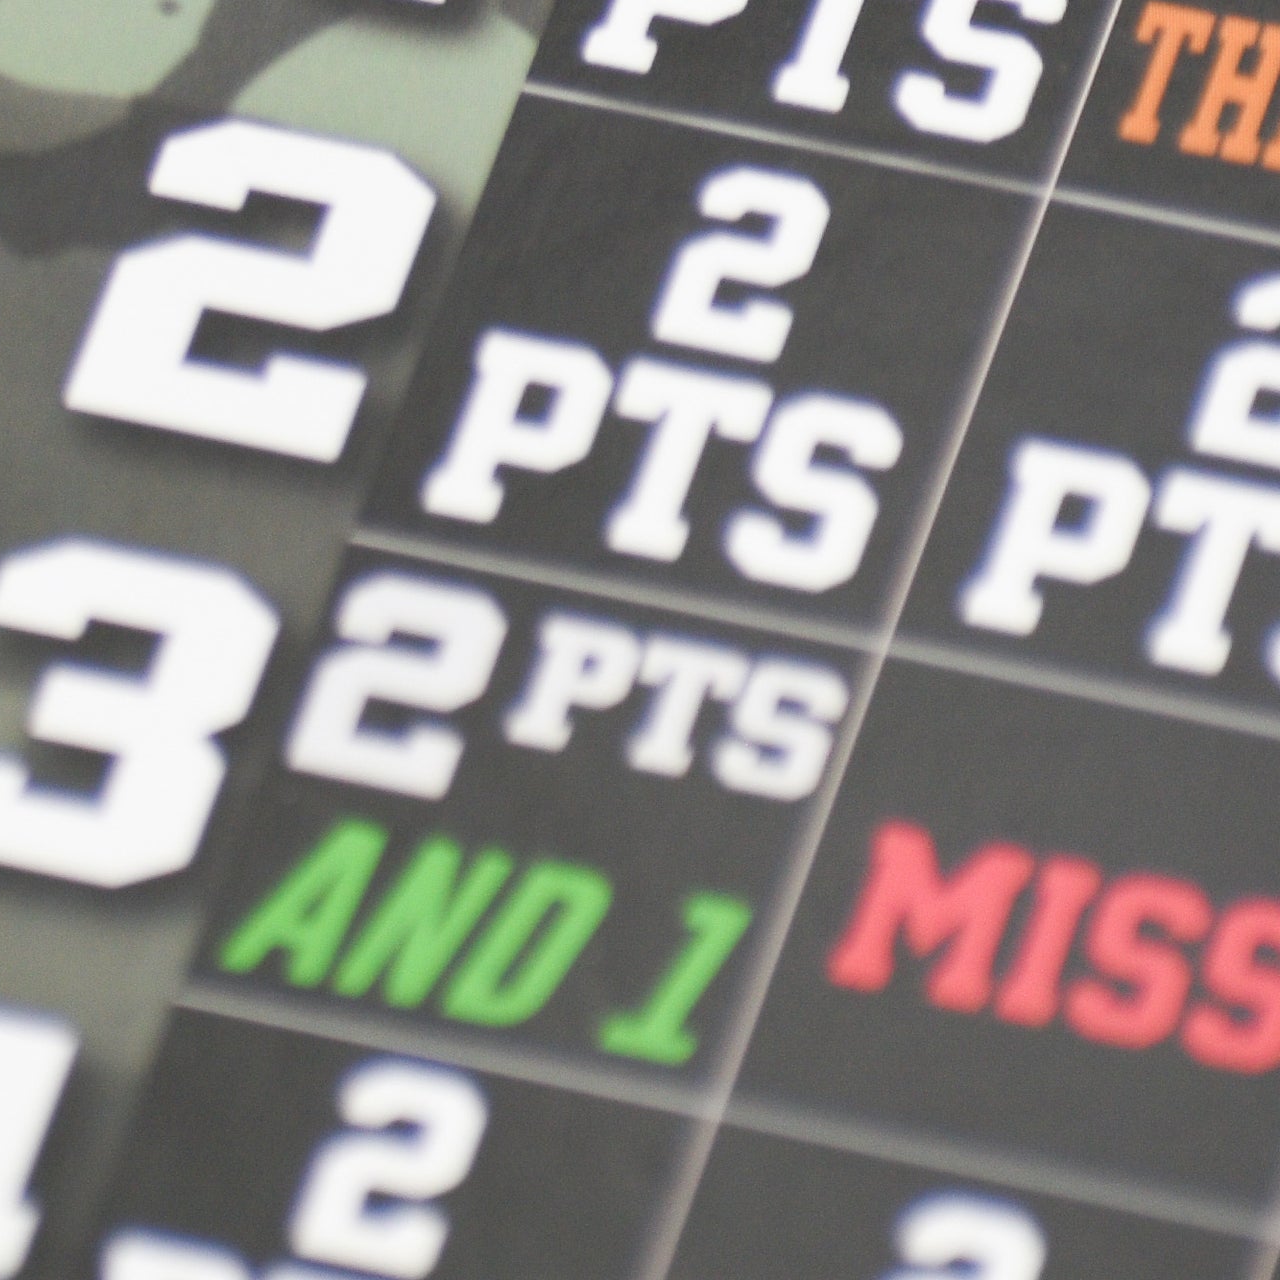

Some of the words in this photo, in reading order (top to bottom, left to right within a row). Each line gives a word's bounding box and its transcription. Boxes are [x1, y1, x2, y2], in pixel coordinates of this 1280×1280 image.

[1118, 0, 1280, 172] TH
[61, 117, 438, 464] 2
[653, 168, 830, 362] 2
[422, 329, 904, 593] PTS
[959, 439, 1280, 682] PT
[288, 575, 506, 798] 2
[507, 616, 849, 800] PTS
[229, 826, 607, 1021] AND
[609, 901, 743, 1056] 1
[829, 822, 1280, 1072] MISS
[293, 1064, 486, 1279] 2
